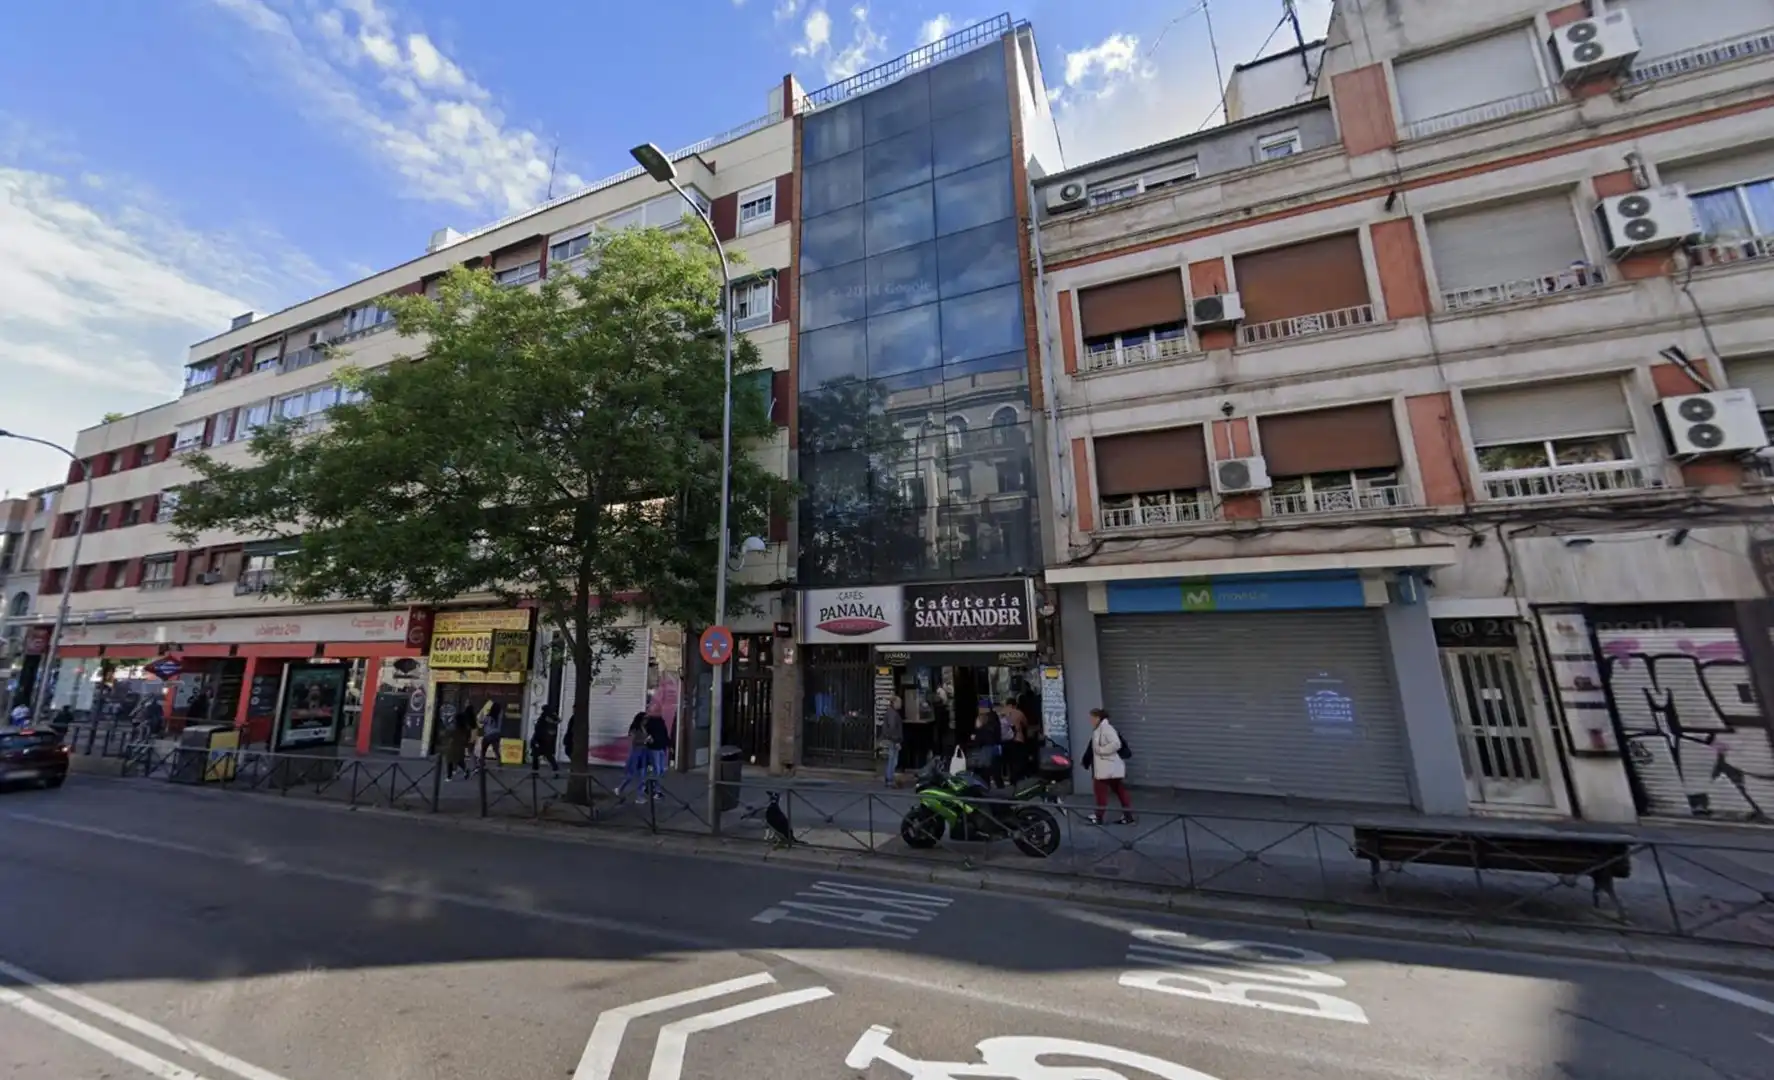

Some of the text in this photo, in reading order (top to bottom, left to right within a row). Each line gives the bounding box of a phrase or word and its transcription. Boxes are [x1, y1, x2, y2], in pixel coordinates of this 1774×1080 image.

[914, 593, 1021, 610] Cafetería
[819, 603, 885, 621] PANAMA
[915, 608, 1022, 628] SANTANDER
[433, 637, 474, 651] COMPRO
[476, 637, 491, 651] OR
[751, 880, 955, 940] TAXI
[1117, 927, 1369, 1025] BUS
